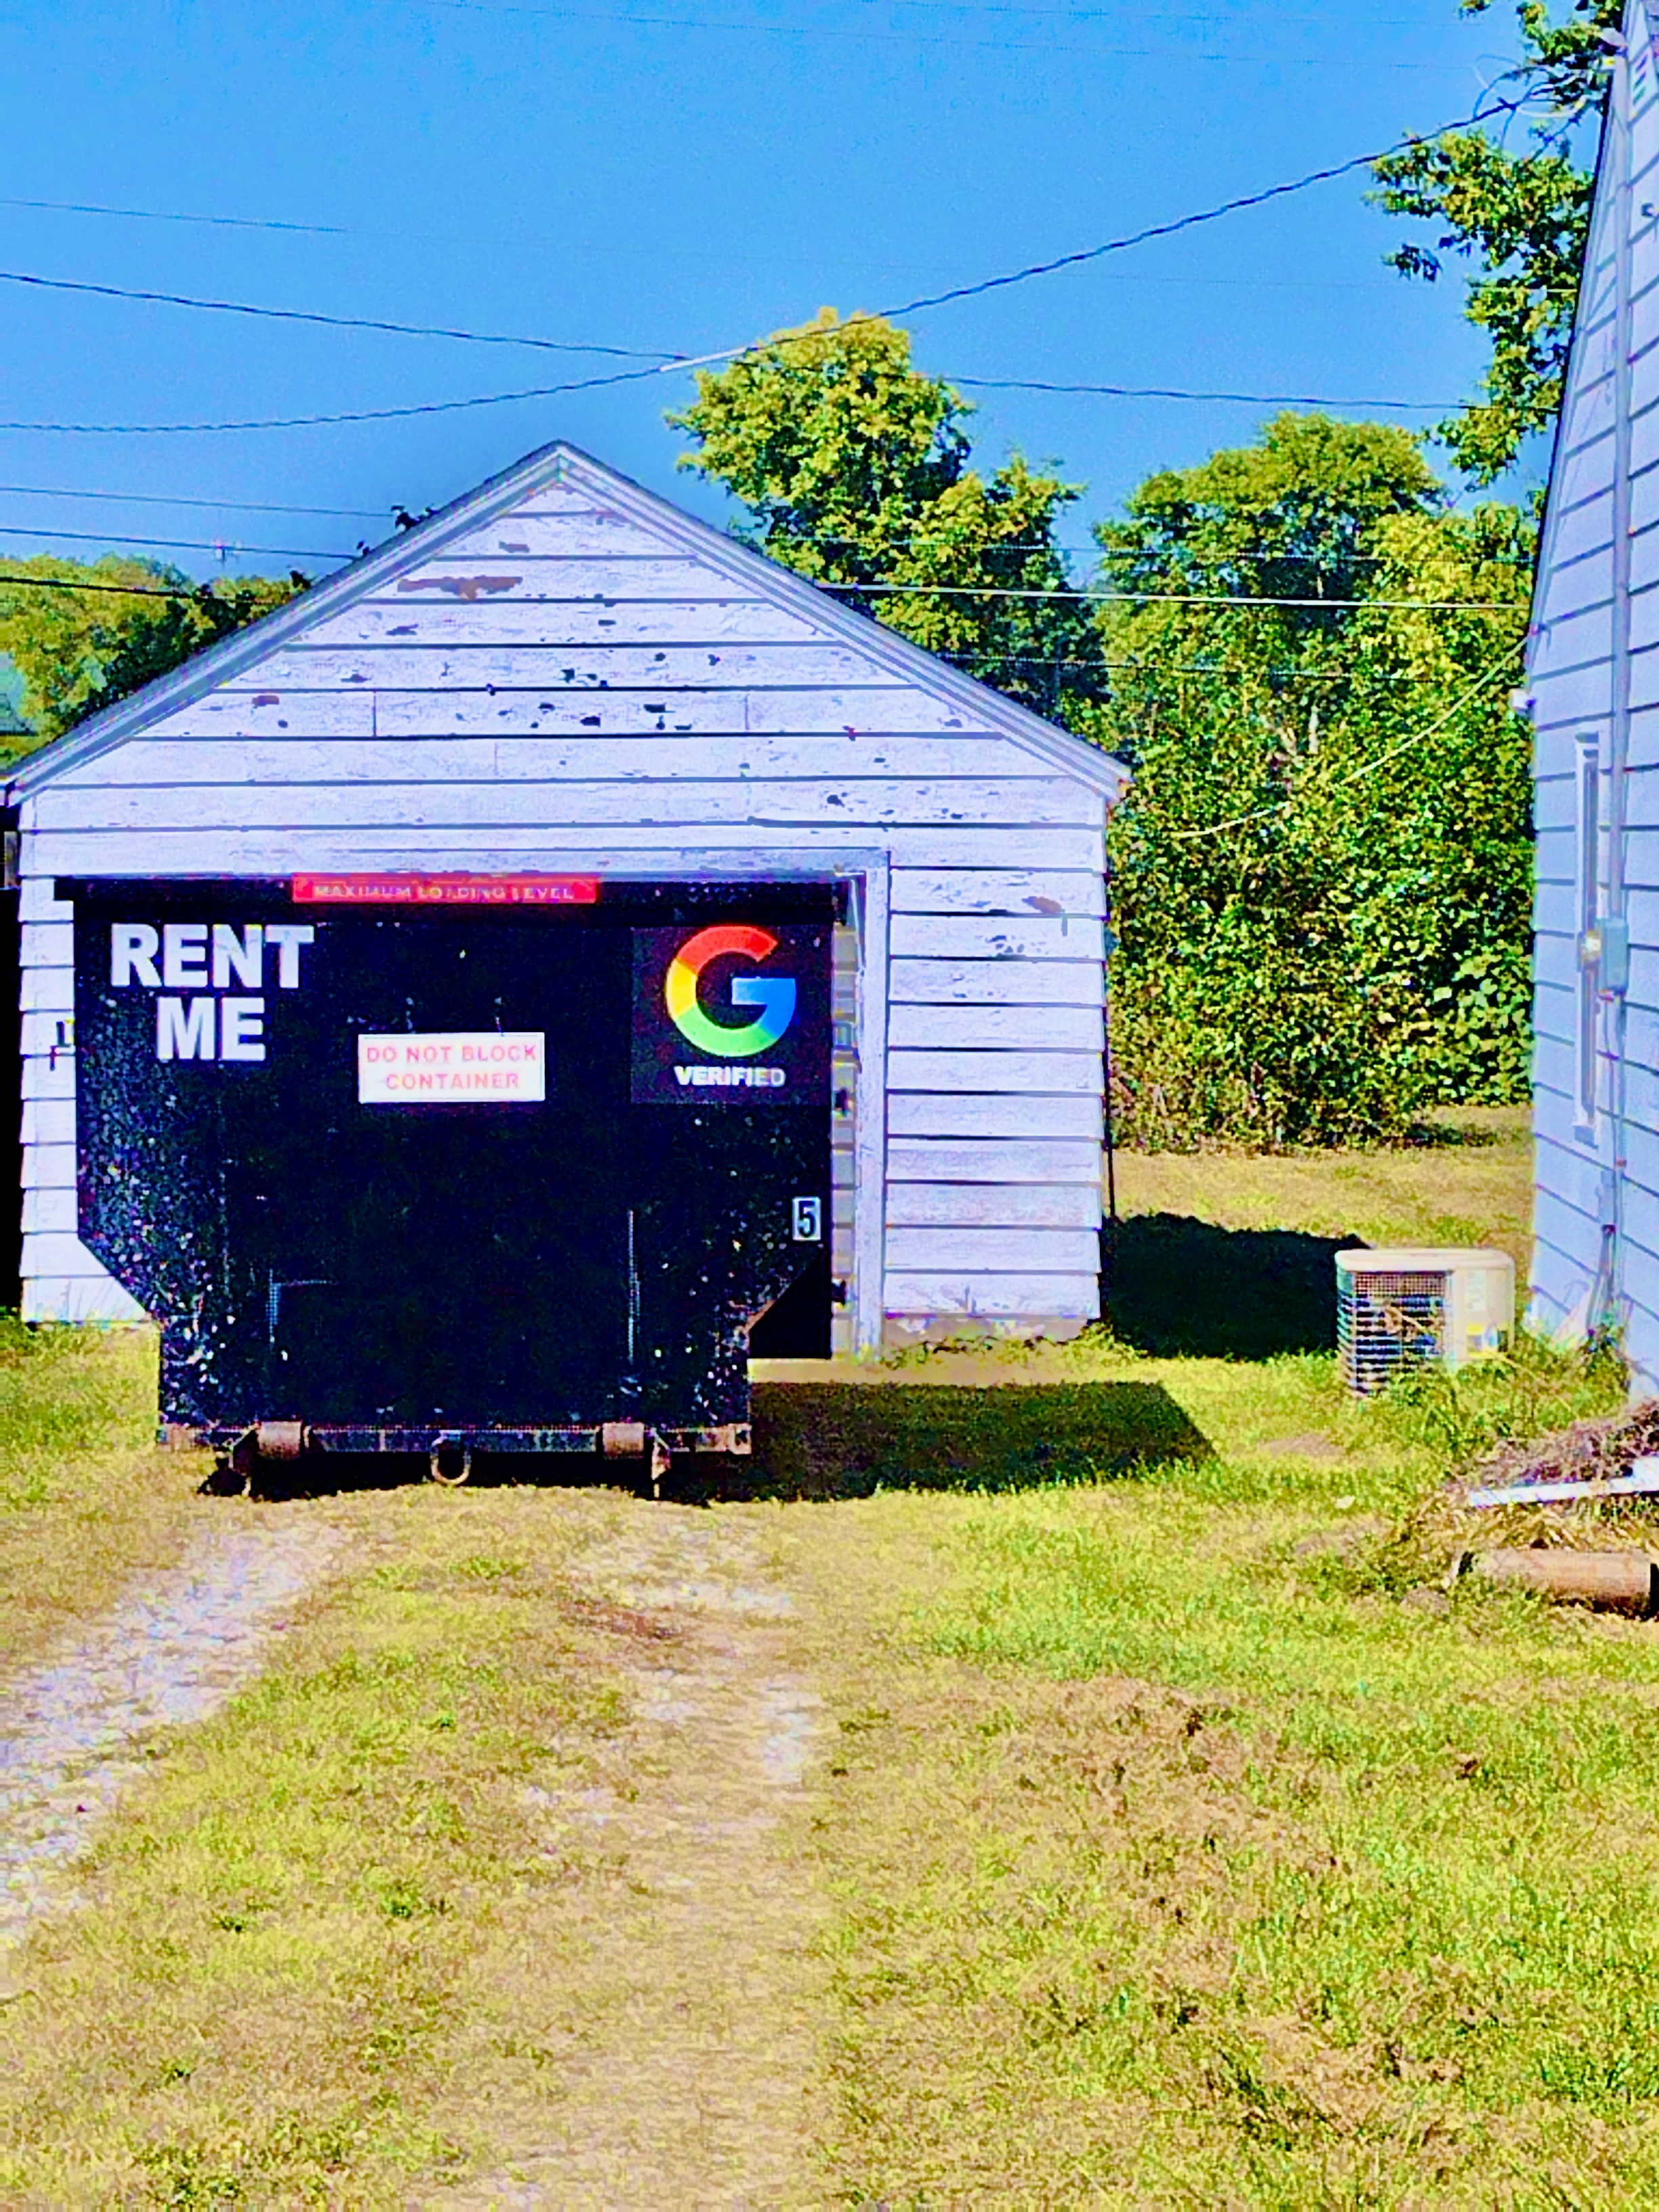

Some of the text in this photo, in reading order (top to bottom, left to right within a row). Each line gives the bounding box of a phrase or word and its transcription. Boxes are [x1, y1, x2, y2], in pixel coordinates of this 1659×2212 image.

[512, 887, 575, 900] LEVEL
[111, 923, 315, 989] RENT
[665, 925, 797, 1058] G
[157, 997, 266, 1062] ME
[367, 1044, 537, 1063] DO NOT BLOCK
[386, 1073, 520, 1090] CONTAINER
[674, 1065, 786, 1087] VERIFIED
[798, 1200, 817, 1238] 5
